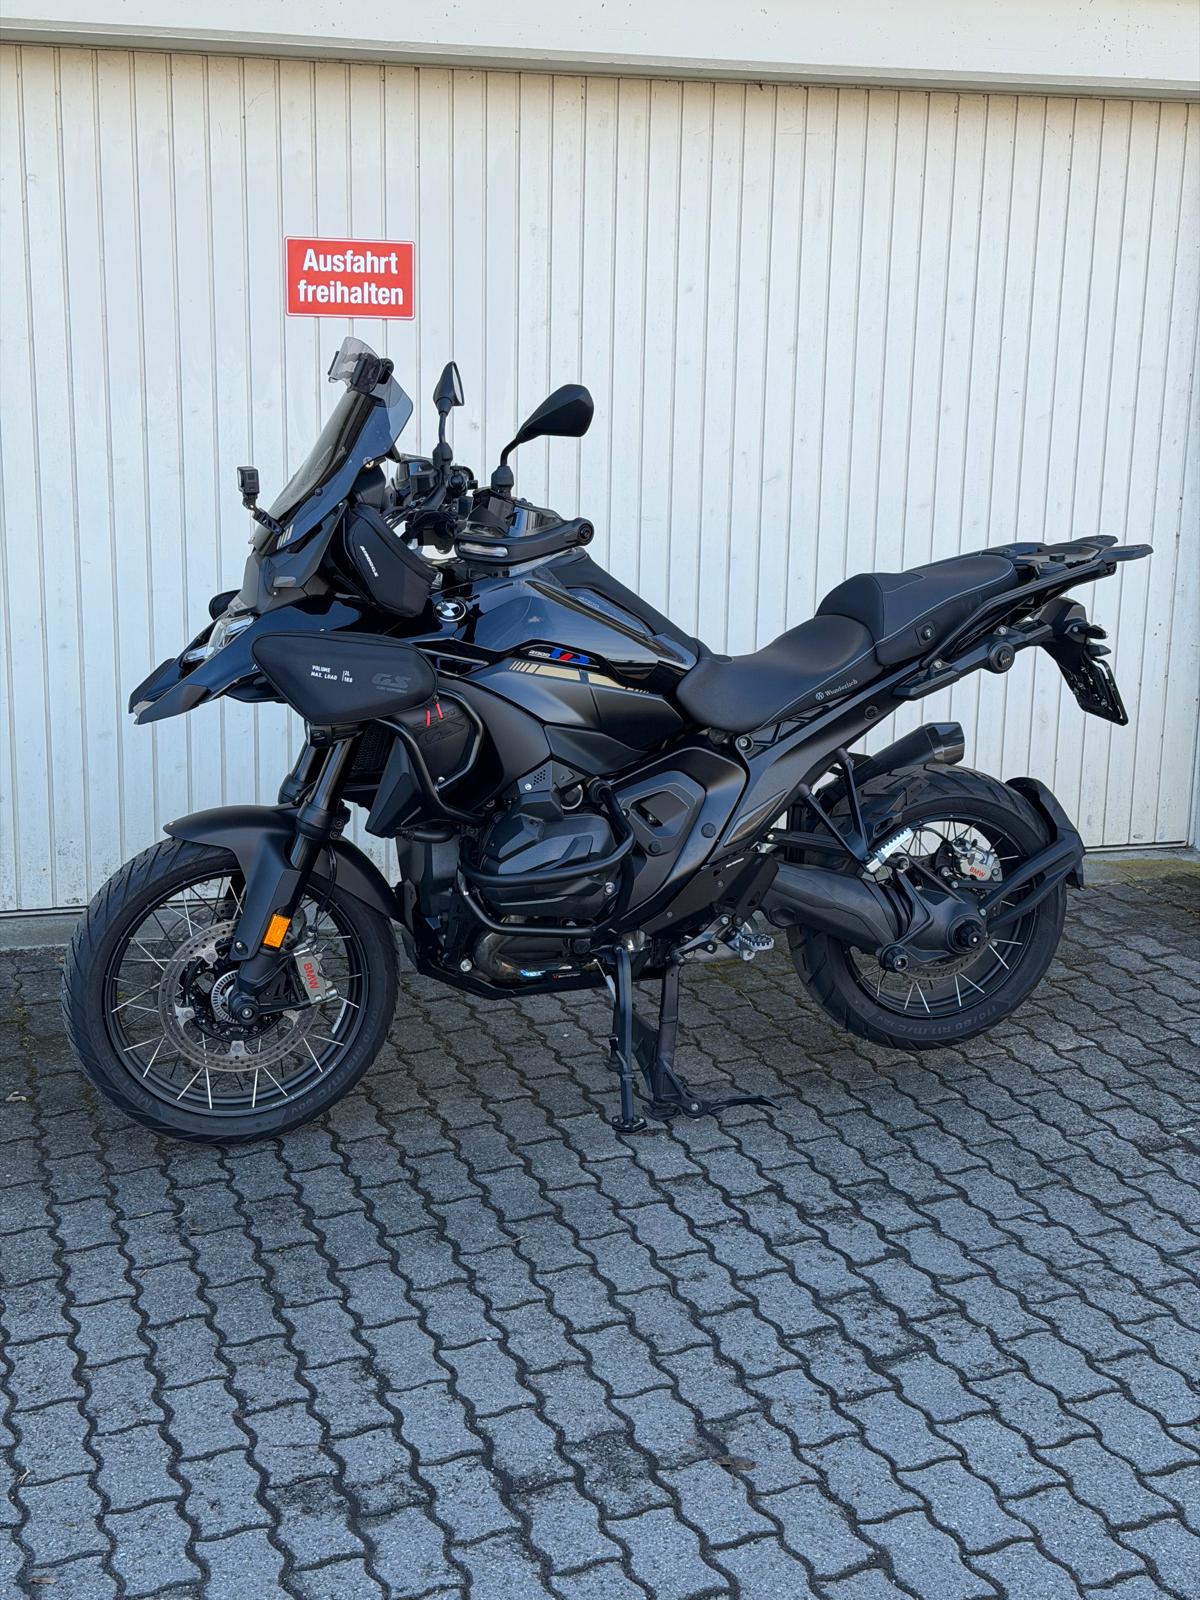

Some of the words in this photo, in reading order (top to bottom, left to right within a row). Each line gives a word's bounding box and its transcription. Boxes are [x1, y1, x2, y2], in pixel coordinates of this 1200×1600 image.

[303, 248, 398, 275] Ausfahrt
[298, 280, 404, 305] freihalten
[312, 665, 331, 673] VOLUME
[324, 673, 338, 681] LOAD
[372, 672, 412, 689] GS
[825, 679, 858, 697] Wunderlich
[969, 866, 986, 878] BMW
[303, 962, 320, 989] BMW
